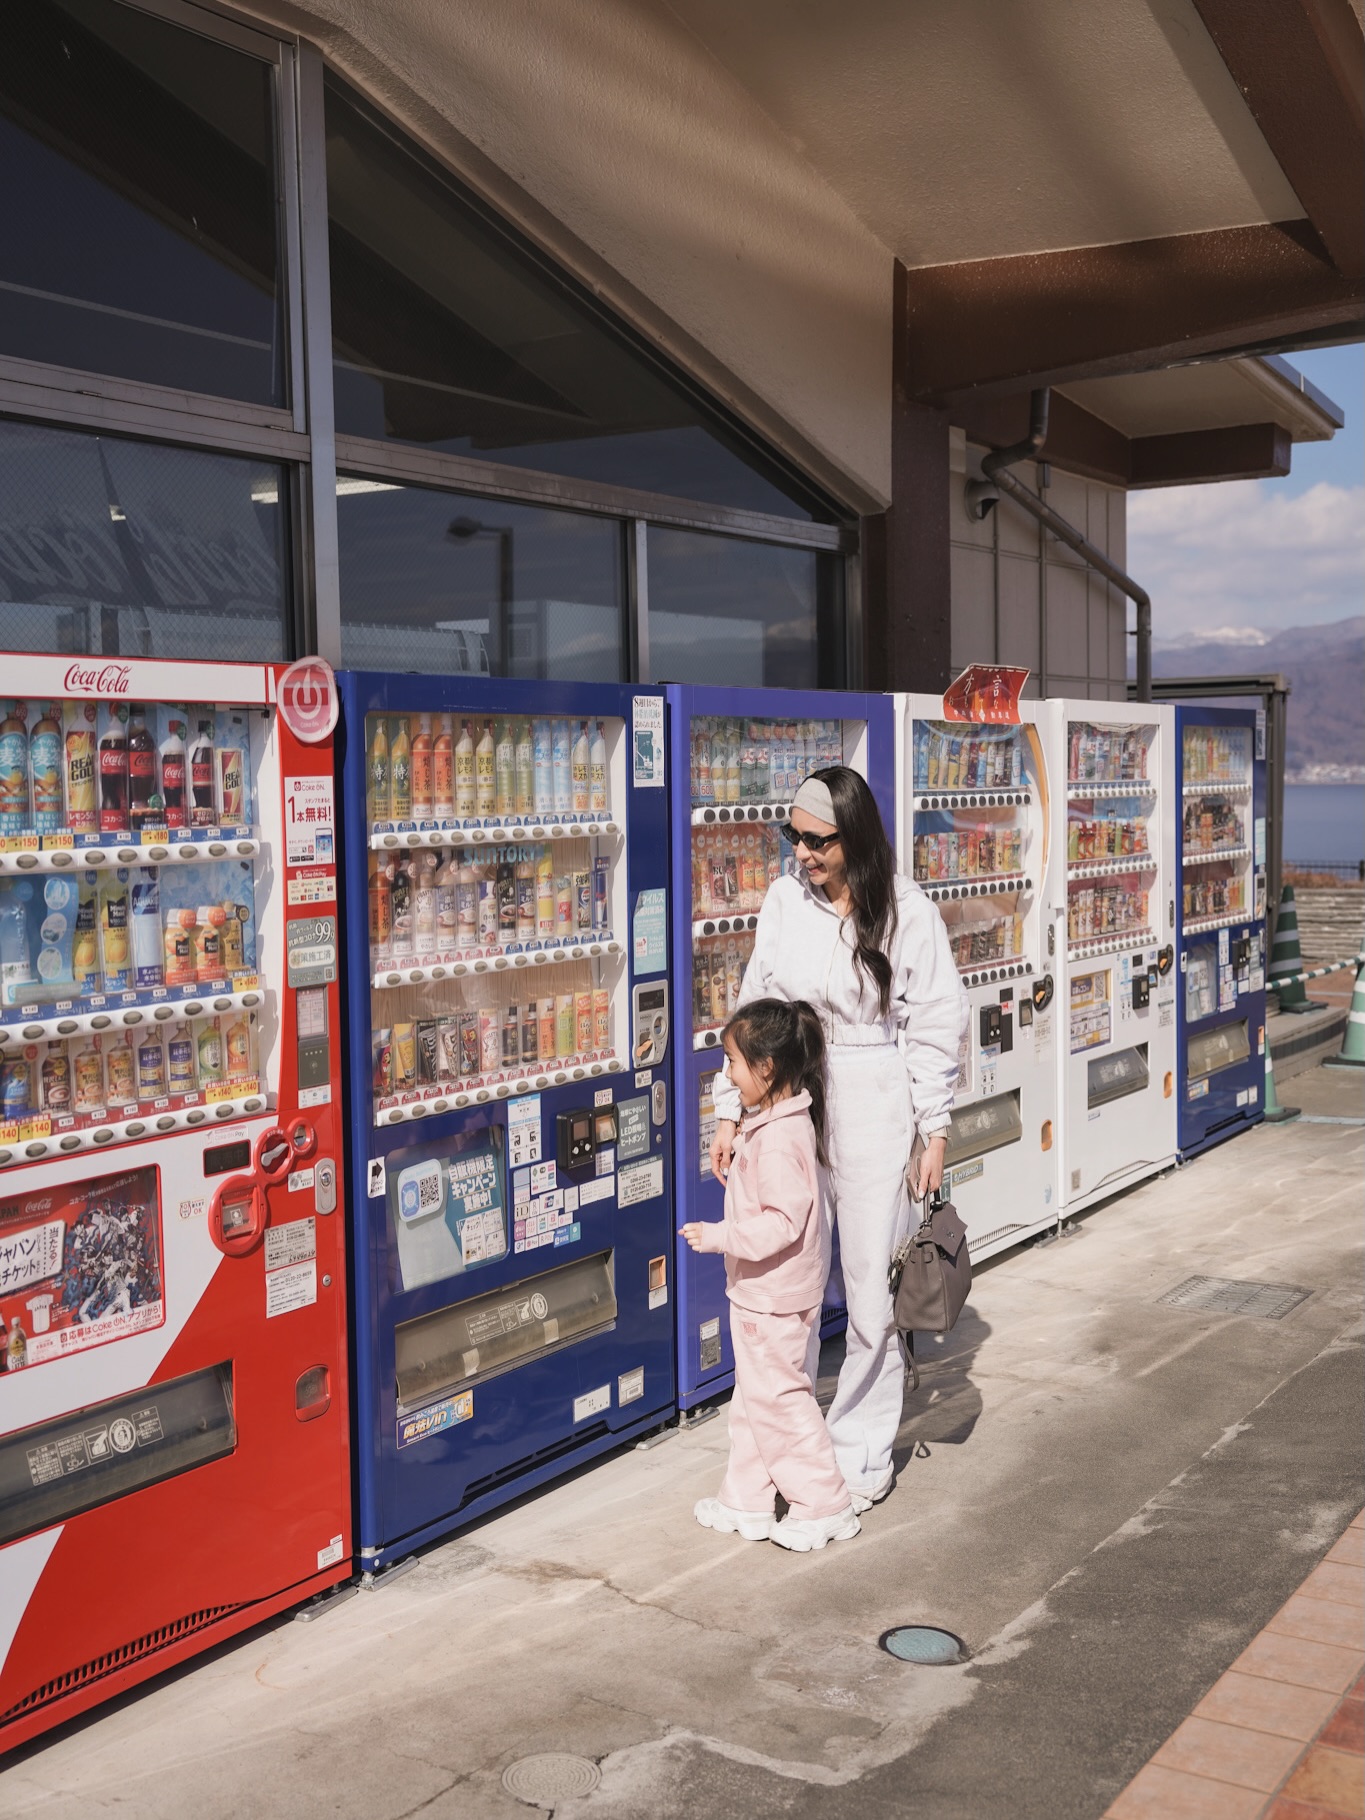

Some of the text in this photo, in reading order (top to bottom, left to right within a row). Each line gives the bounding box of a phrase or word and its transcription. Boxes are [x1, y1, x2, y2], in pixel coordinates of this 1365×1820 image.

[448, 1154, 495, 1180] 自販機限定
[451, 1172, 497, 1198] キャンペーン
